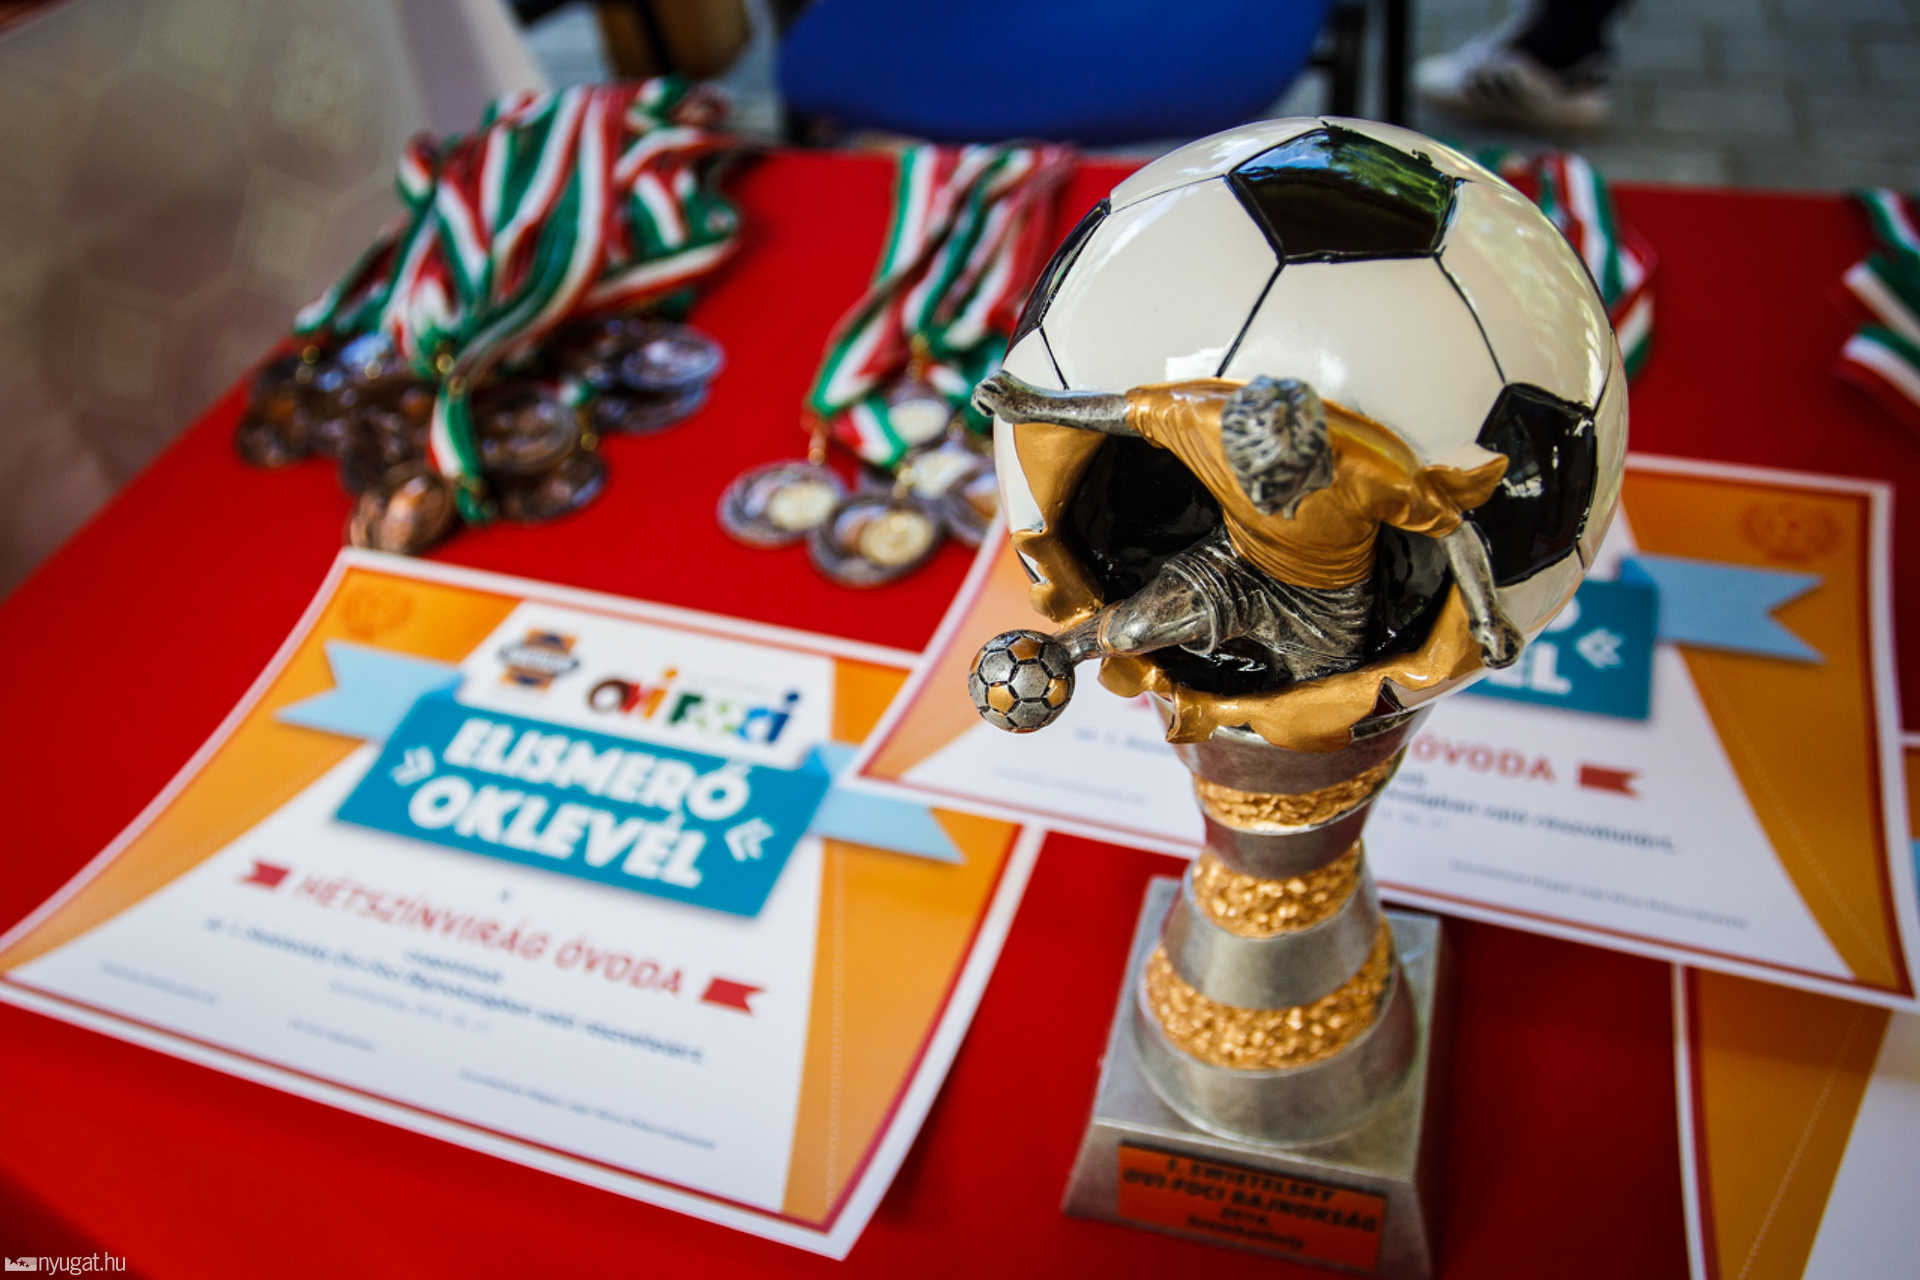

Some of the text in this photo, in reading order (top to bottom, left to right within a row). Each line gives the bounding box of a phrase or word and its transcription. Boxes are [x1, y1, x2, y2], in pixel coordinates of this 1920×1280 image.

[442, 717, 752, 822] ELISMERŐ
[408, 774, 707, 889] OKLEVÉL
[552, 935, 685, 997] ÓVODA
